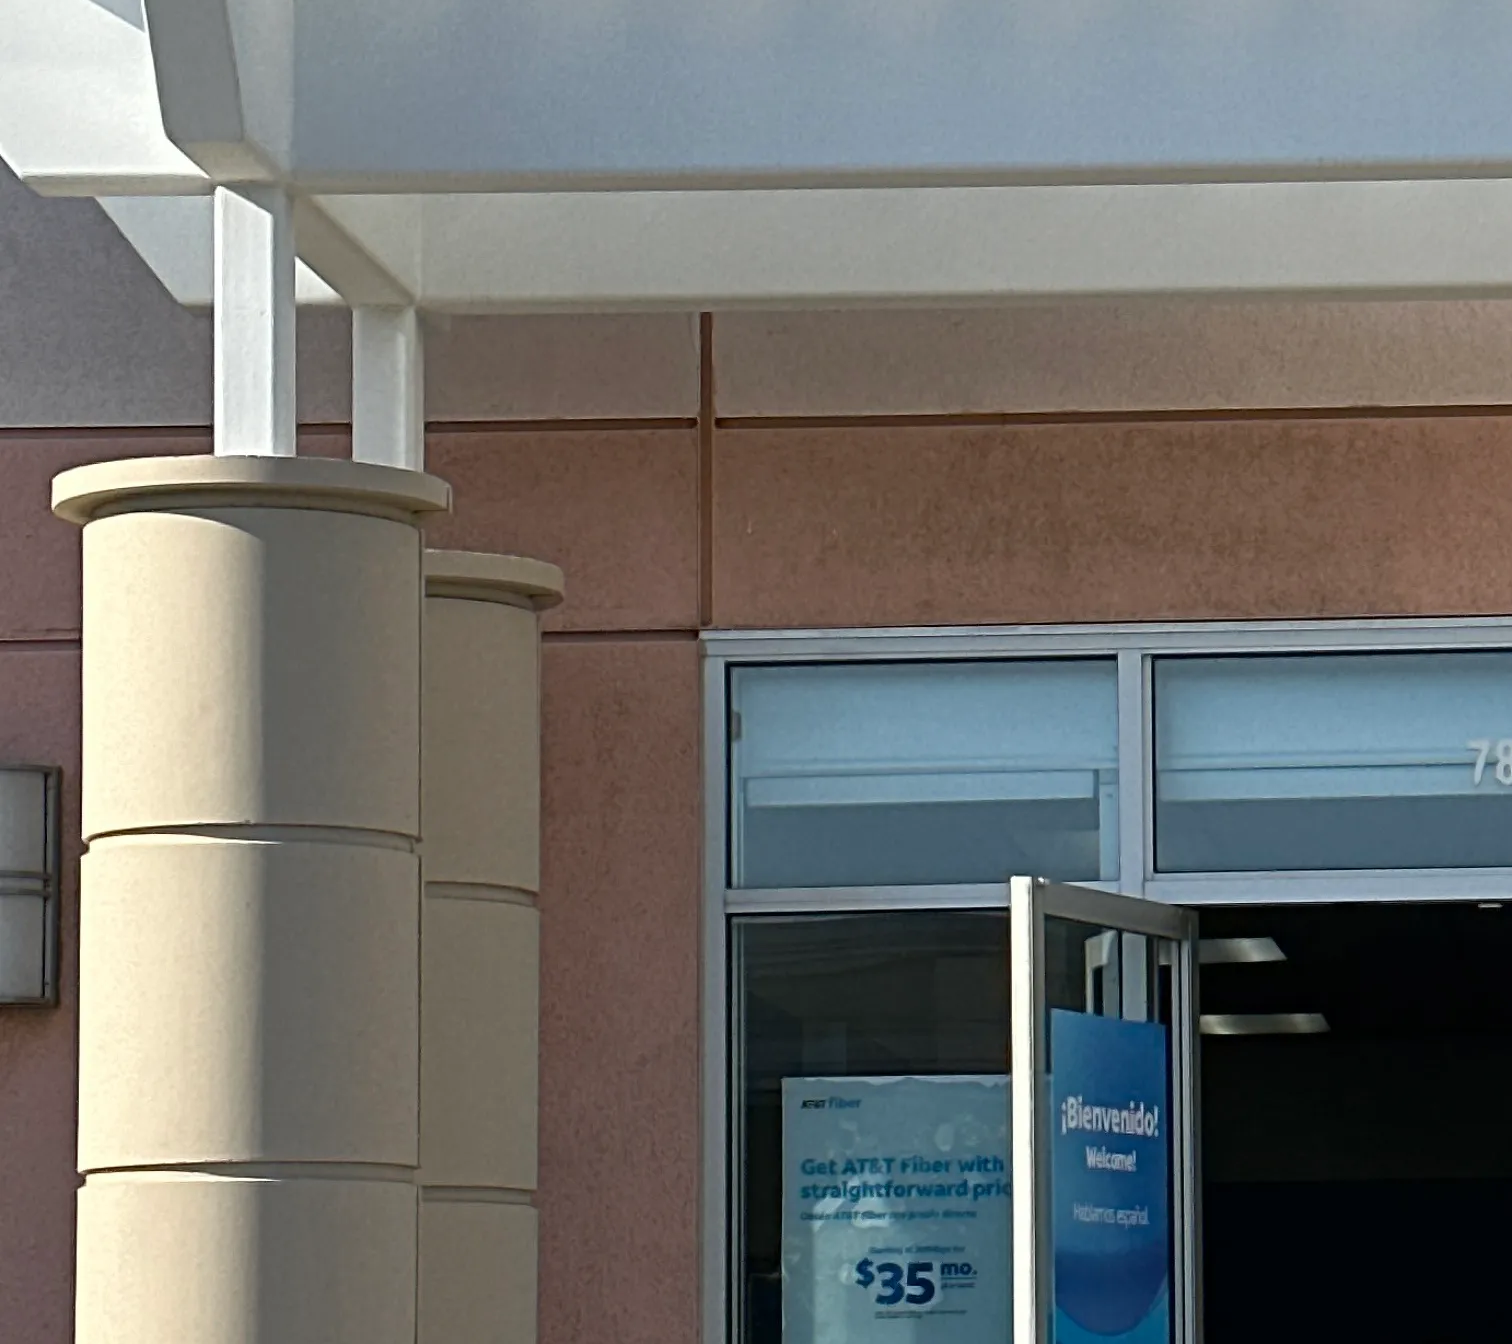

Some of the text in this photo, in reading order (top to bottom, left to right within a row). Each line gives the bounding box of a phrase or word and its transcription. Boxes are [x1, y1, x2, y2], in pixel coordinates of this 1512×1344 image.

[1060, 1094, 1160, 1138] ¡Bienvenido!
[801, 1154, 1005, 1175] Get AT&T Fiber with
[1085, 1145, 1138, 1172] Welcome!
[800, 1179, 968, 1202] straightforward
[940, 1261, 978, 1276] mo.
